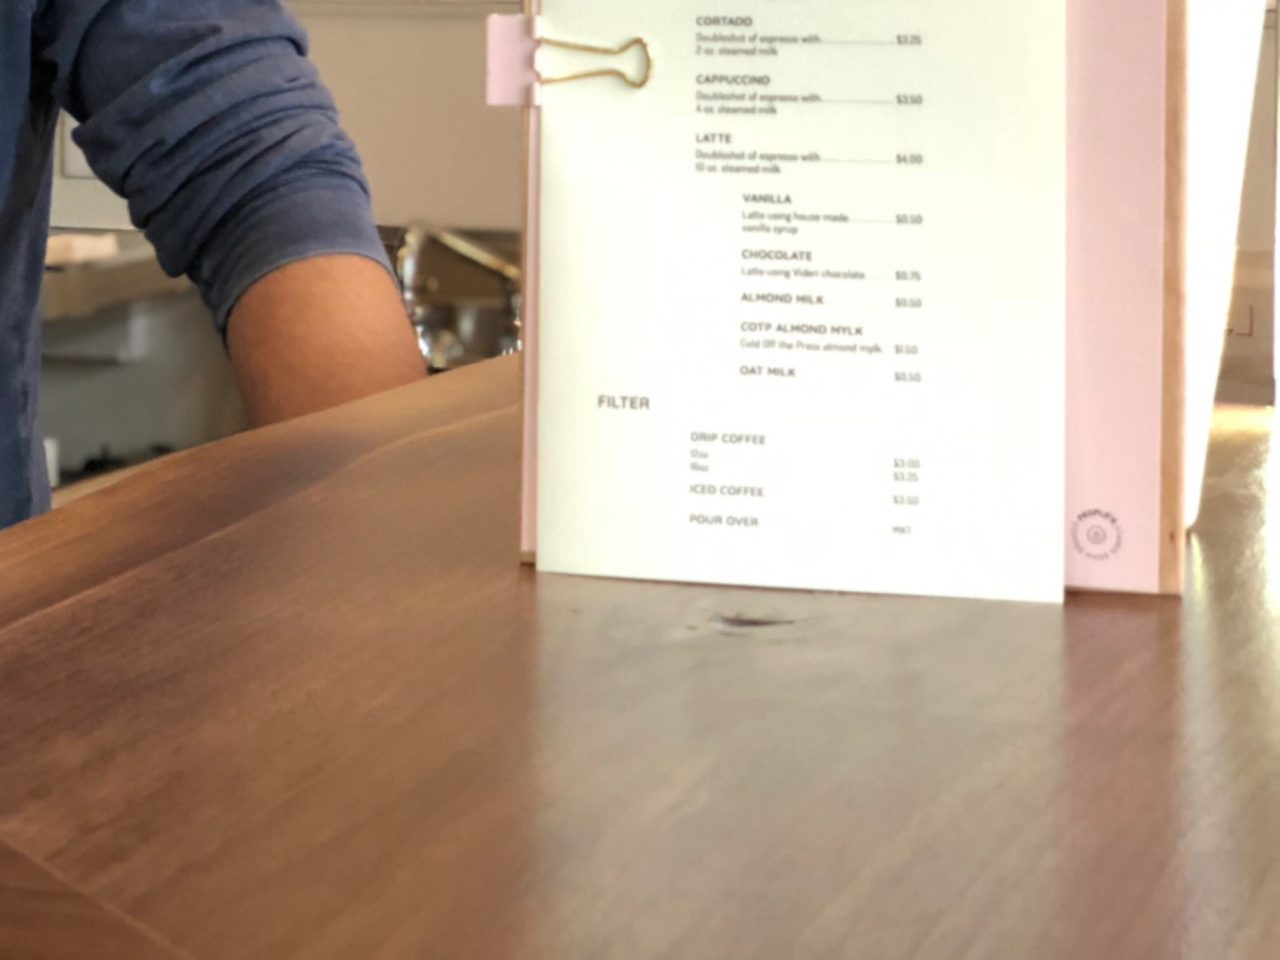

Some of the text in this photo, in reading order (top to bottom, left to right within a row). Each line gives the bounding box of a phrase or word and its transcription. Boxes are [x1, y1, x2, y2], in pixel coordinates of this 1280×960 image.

[695, 16, 754, 26] CORTADO
[695, 32, 746, 43] Doubleshot
[748, 33, 758, 43] of
[759, 35, 799, 46] espresso
[801, 34, 821, 44] with
[695, 45, 703, 55] 2
[718, 46, 757, 56] steamed
[758, 46, 779, 56] milk
[695, 74, 771, 85] CAPPUCCINO
[695, 90, 923, 105] Doubleshot of espresso with $3.50
[695, 105, 702, 113] 4
[718, 105, 757, 115] steamed
[757, 105, 778, 115] milk
[695, 133, 733, 144] LATTE
[695, 149, 923, 165] Doubleshot of espresso with $4.00
[721, 164, 760, 174] steamed
[761, 164, 782, 174] milk
[742, 193, 792, 205] VANILLA
[742, 210, 923, 225] Latte using house made $0.50
[741, 224, 799, 235] vanilla syrup
[741, 249, 813, 262] CHOCOLATE
[741, 266, 765, 277] Latte
[766, 268, 791, 279] using
[821, 269, 866, 280] chocolate
[895, 271, 922, 282] $0.75
[741, 292, 922, 309] ALMOND MILK $0.50
[740, 321, 863, 336] COTP ALMOND MYLK
[740, 338, 761, 349] Cold
[778, 340, 794, 350] the
[795, 340, 820, 351] Press
[823, 342, 857, 352] almond
[739, 365, 921, 383] OAT MILK $0.50
[597, 394, 650, 410] FILTER
[690, 431, 766, 445] DRIP COFFEE
[689, 484, 717, 495] ICED
[719, 485, 764, 497] COFFEE
[689, 513, 723, 525] POUR
[726, 515, 759, 527] OVER
